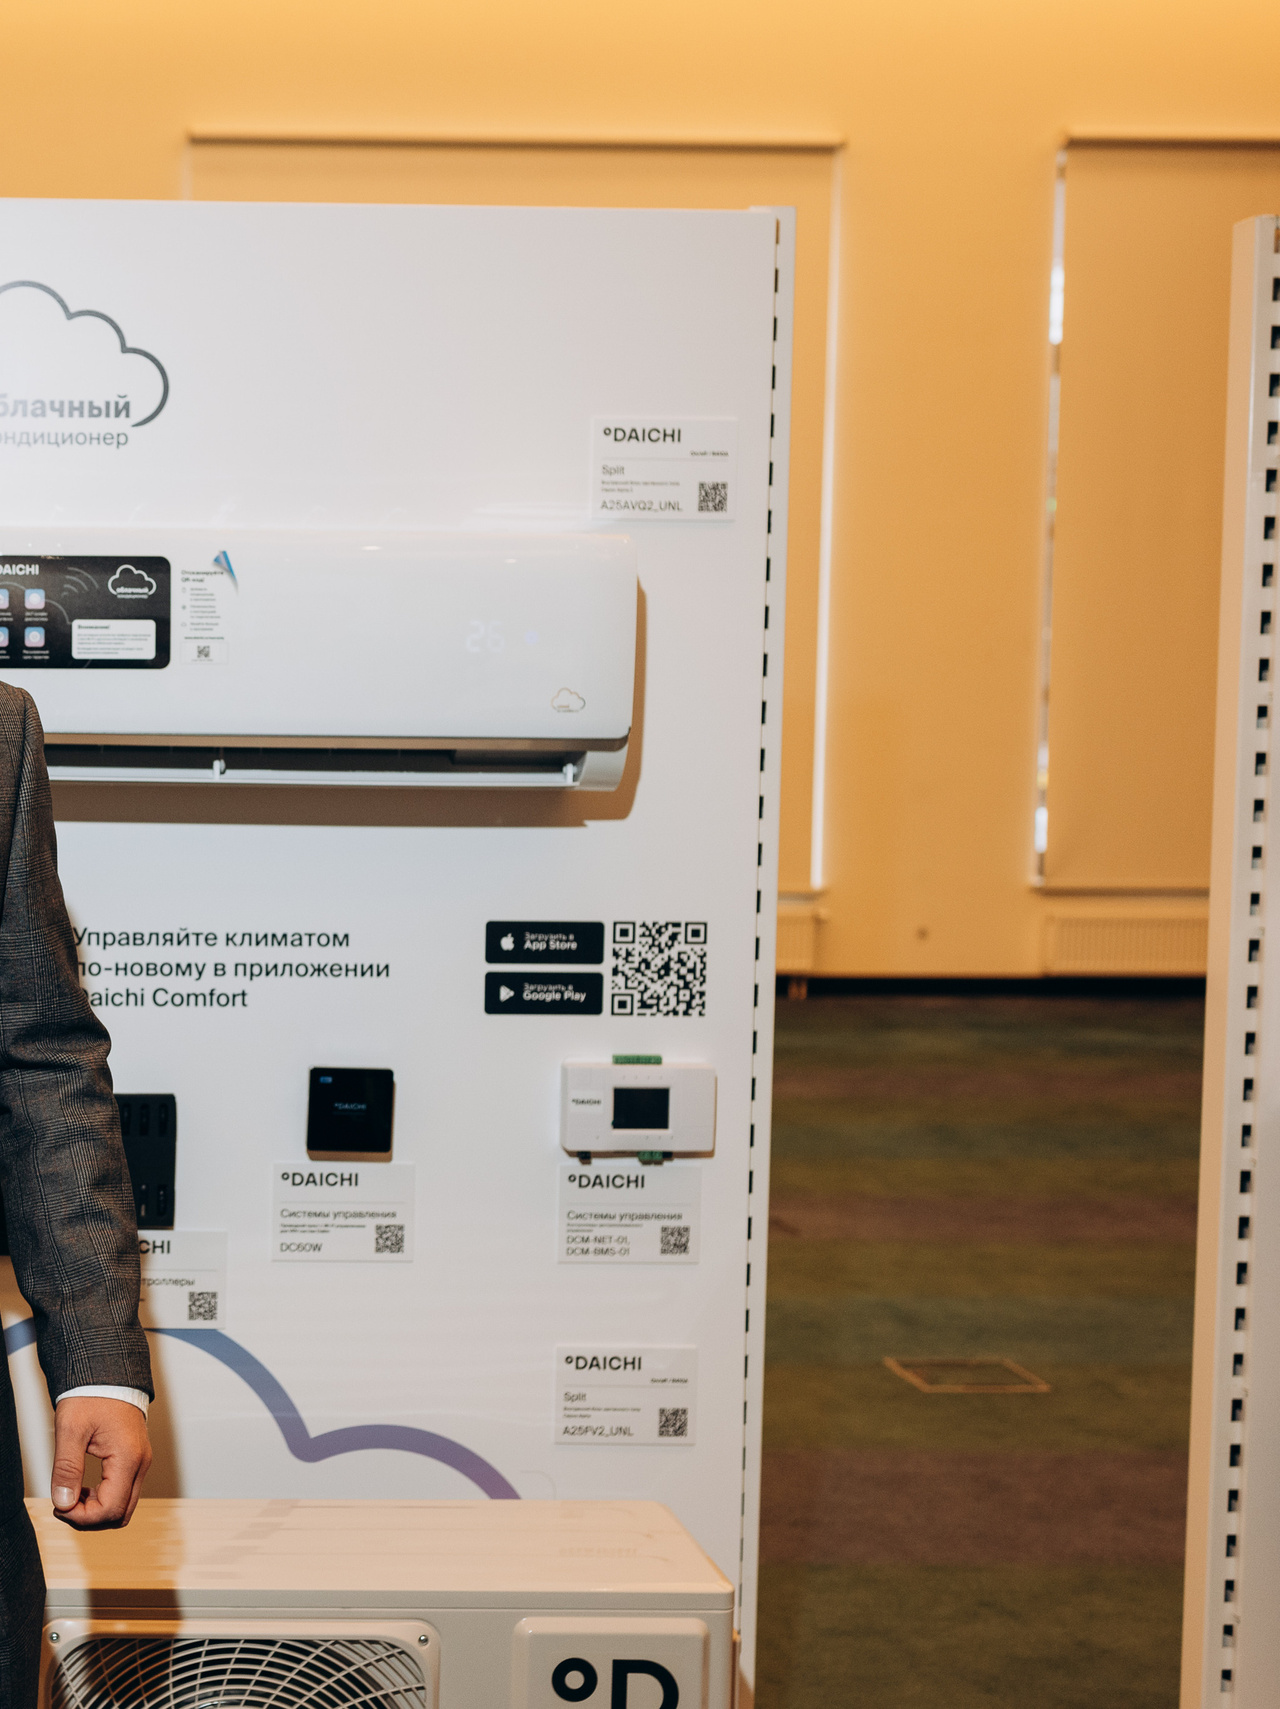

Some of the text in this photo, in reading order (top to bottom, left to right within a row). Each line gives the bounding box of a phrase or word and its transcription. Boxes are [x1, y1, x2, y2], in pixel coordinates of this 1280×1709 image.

[601, 464, 625, 476] Split
[73, 926, 351, 951] Управляйте климатом
[523, 940, 578, 951] App Store
[214, 962, 227, 977] в
[234, 962, 391, 981] приложении
[152, 988, 248, 1008] Comfort
[522, 990, 587, 1003] Google Play
[280, 1208, 397, 1220] Системы управления
[567, 1210, 683, 1222] Системы управления
[563, 1392, 587, 1403] Split
